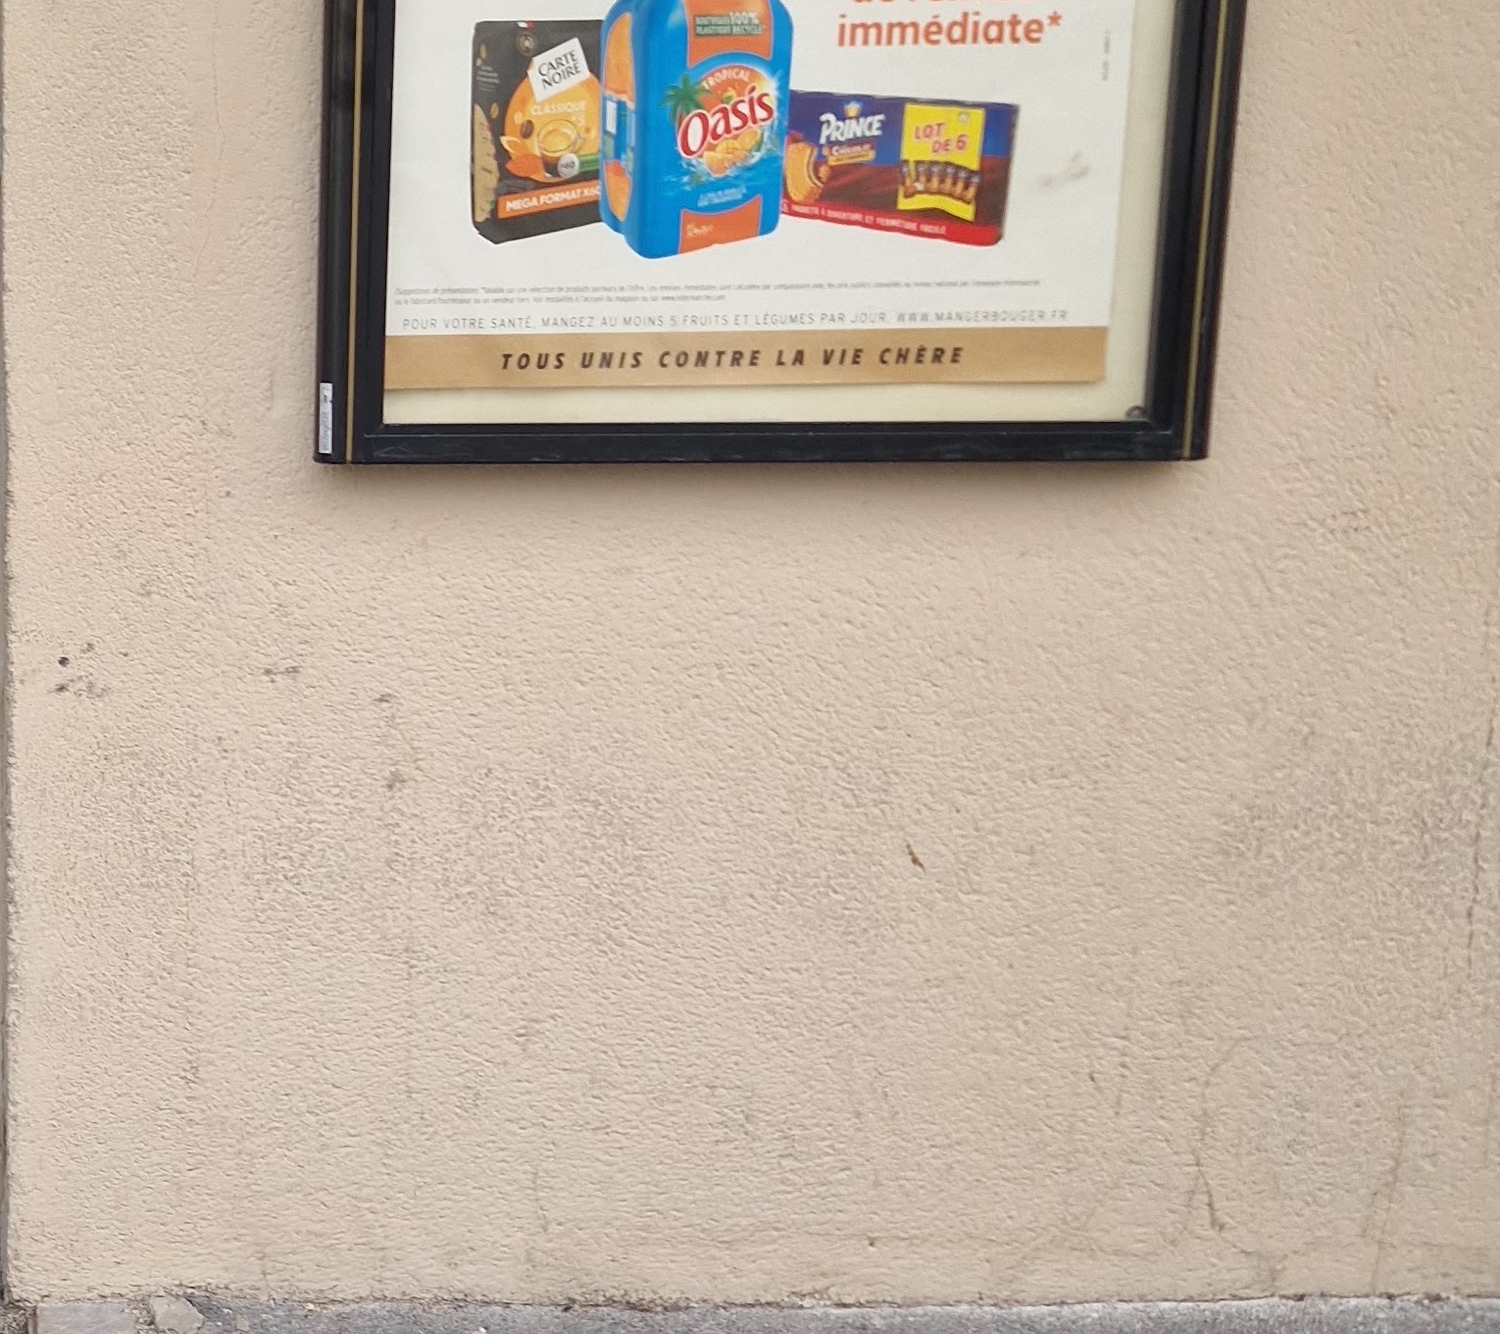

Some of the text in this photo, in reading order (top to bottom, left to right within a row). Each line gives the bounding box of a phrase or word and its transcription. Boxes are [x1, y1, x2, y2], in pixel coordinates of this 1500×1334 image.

[538, 49, 578, 77] CARTE
[541, 62, 581, 89] NOIRE
[702, 68, 749, 90] TROPICAL
[677, 83, 774, 158] Oasis
[819, 112, 886, 145] PRINCE
[913, 122, 945, 141] LOT
[931, 133, 968, 154] DE 6
[505, 188, 581, 212] MEGA FORMAT
[402, 318, 437, 330] POUR
[444, 317, 485, 330] VOTRE
[541, 316, 595, 329] MANGEZ
[600, 316, 618, 328] AU
[623, 315, 665, 328] MOINS
[683, 314, 729, 326] FRUITS
[733, 314, 749, 326] ET
[754, 311, 815, 326] LÉGUMES
[820, 312, 845, 324] PAR
[501, 344, 964, 370] TOUS UNIS CONTRE LA VIE CHÈRE
